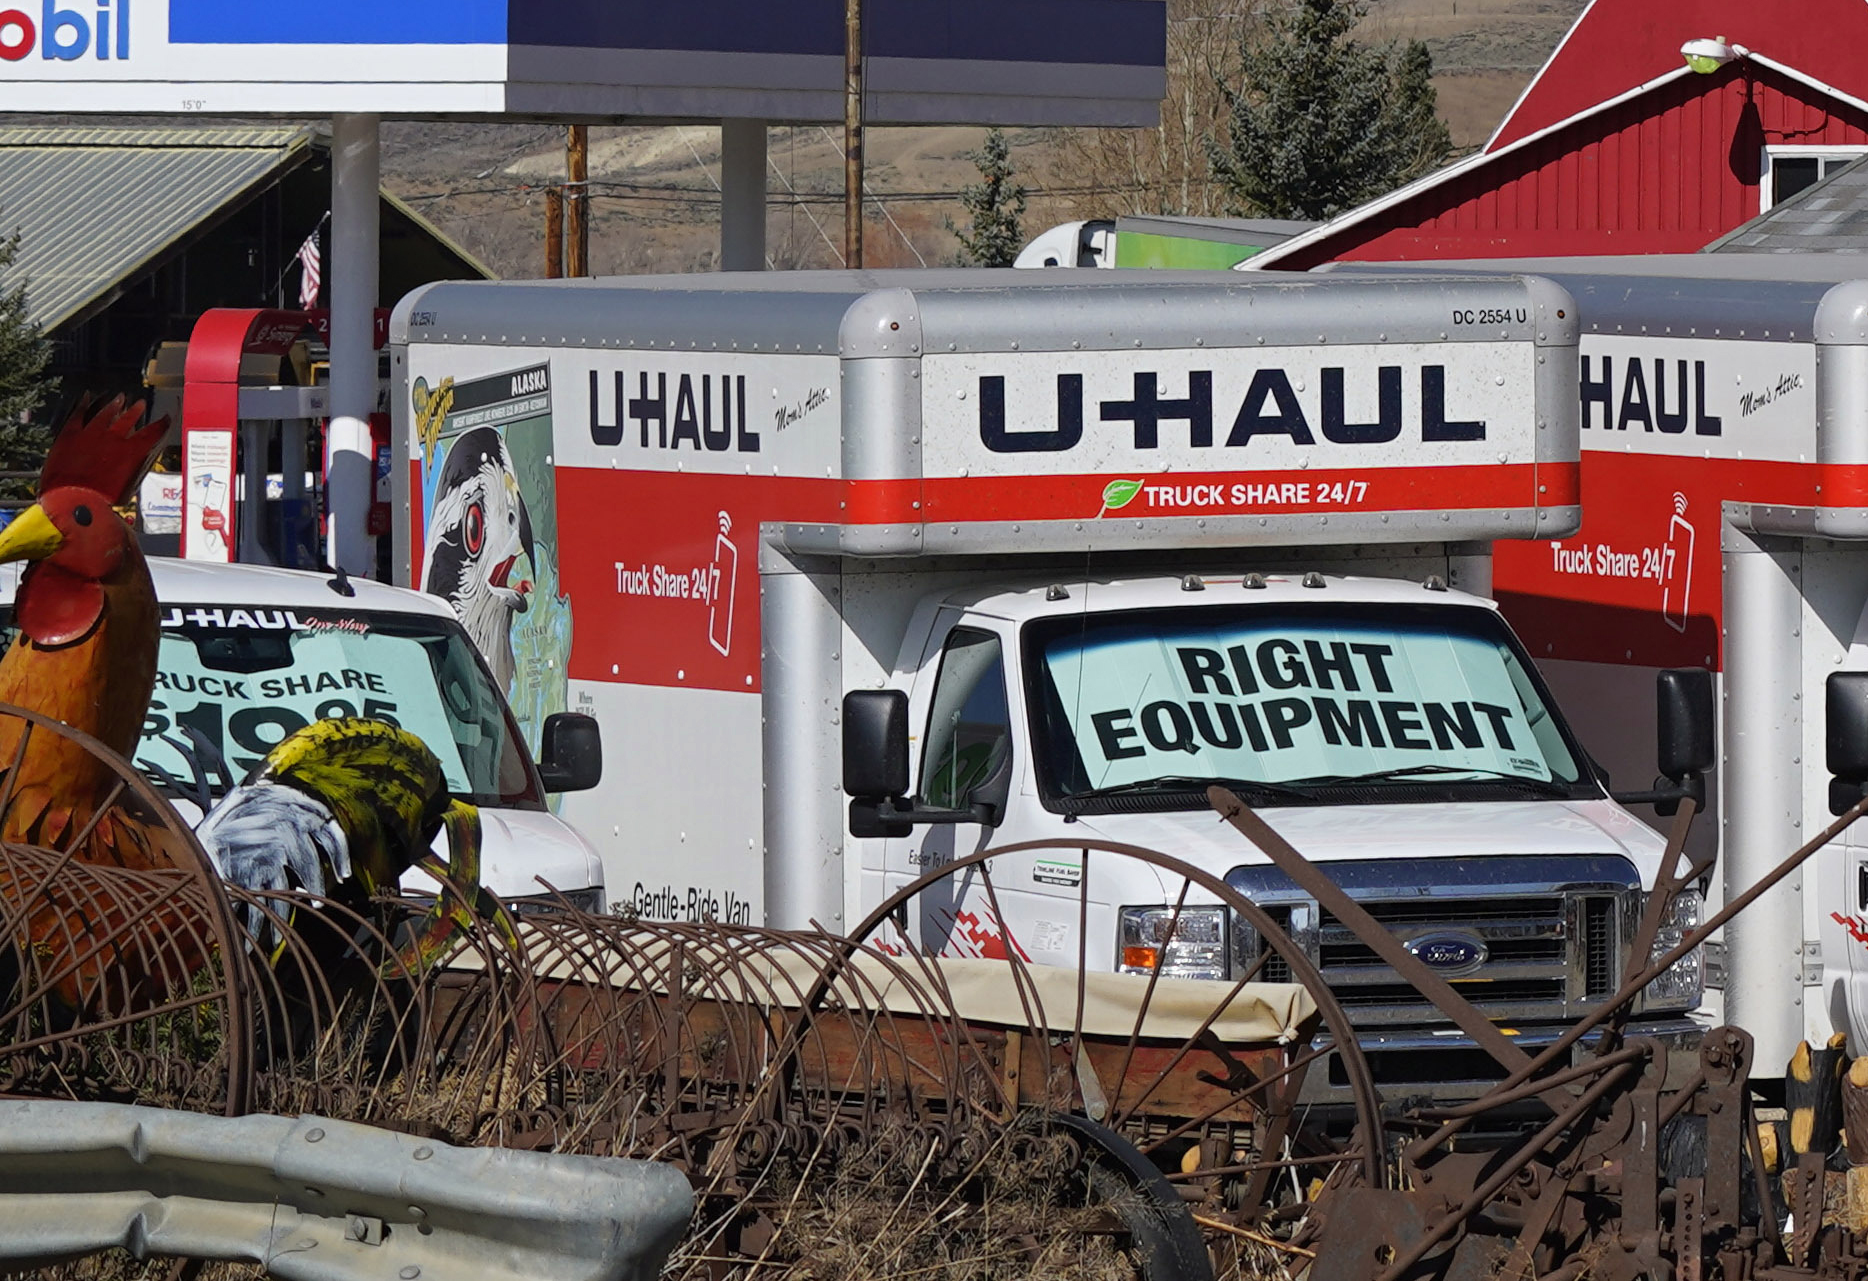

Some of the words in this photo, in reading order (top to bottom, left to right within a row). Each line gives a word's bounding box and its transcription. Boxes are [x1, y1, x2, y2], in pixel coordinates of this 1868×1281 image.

[318, 318, 329, 332] 2
[376, 317, 385, 332] 1
[1453, 309, 1475, 325] DC
[1479, 308, 1512, 324] 2554
[1516, 307, 1527, 324] U
[511, 369, 547, 396] ALASKA
[589, 369, 761, 453] U-HAUL
[979, 364, 1487, 453] U-HAUL
[1739, 387, 1771, 418] Mom's
[1143, 486, 1225, 507] TRUCK
[1230, 484, 1311, 506] SHARE
[1316, 480, 1368, 505] 24/7
[1550, 541, 1593, 574] Truck
[1596, 544, 1640, 578] Share
[1642, 542, 1676, 586] 24/7
[615, 562, 651, 595] Truck
[652, 564, 690, 599] Share
[691, 561, 722, 606] 24/7
[1176, 638, 1393, 696] RIGHT
[260, 669, 388, 699] SHARE
[1091, 696, 1517, 761] EQUIPMENT
[633, 881, 719, 924] Gentle-Ride
[725, 890, 750, 927] Van
[1427, 945, 1465, 962] Ford
